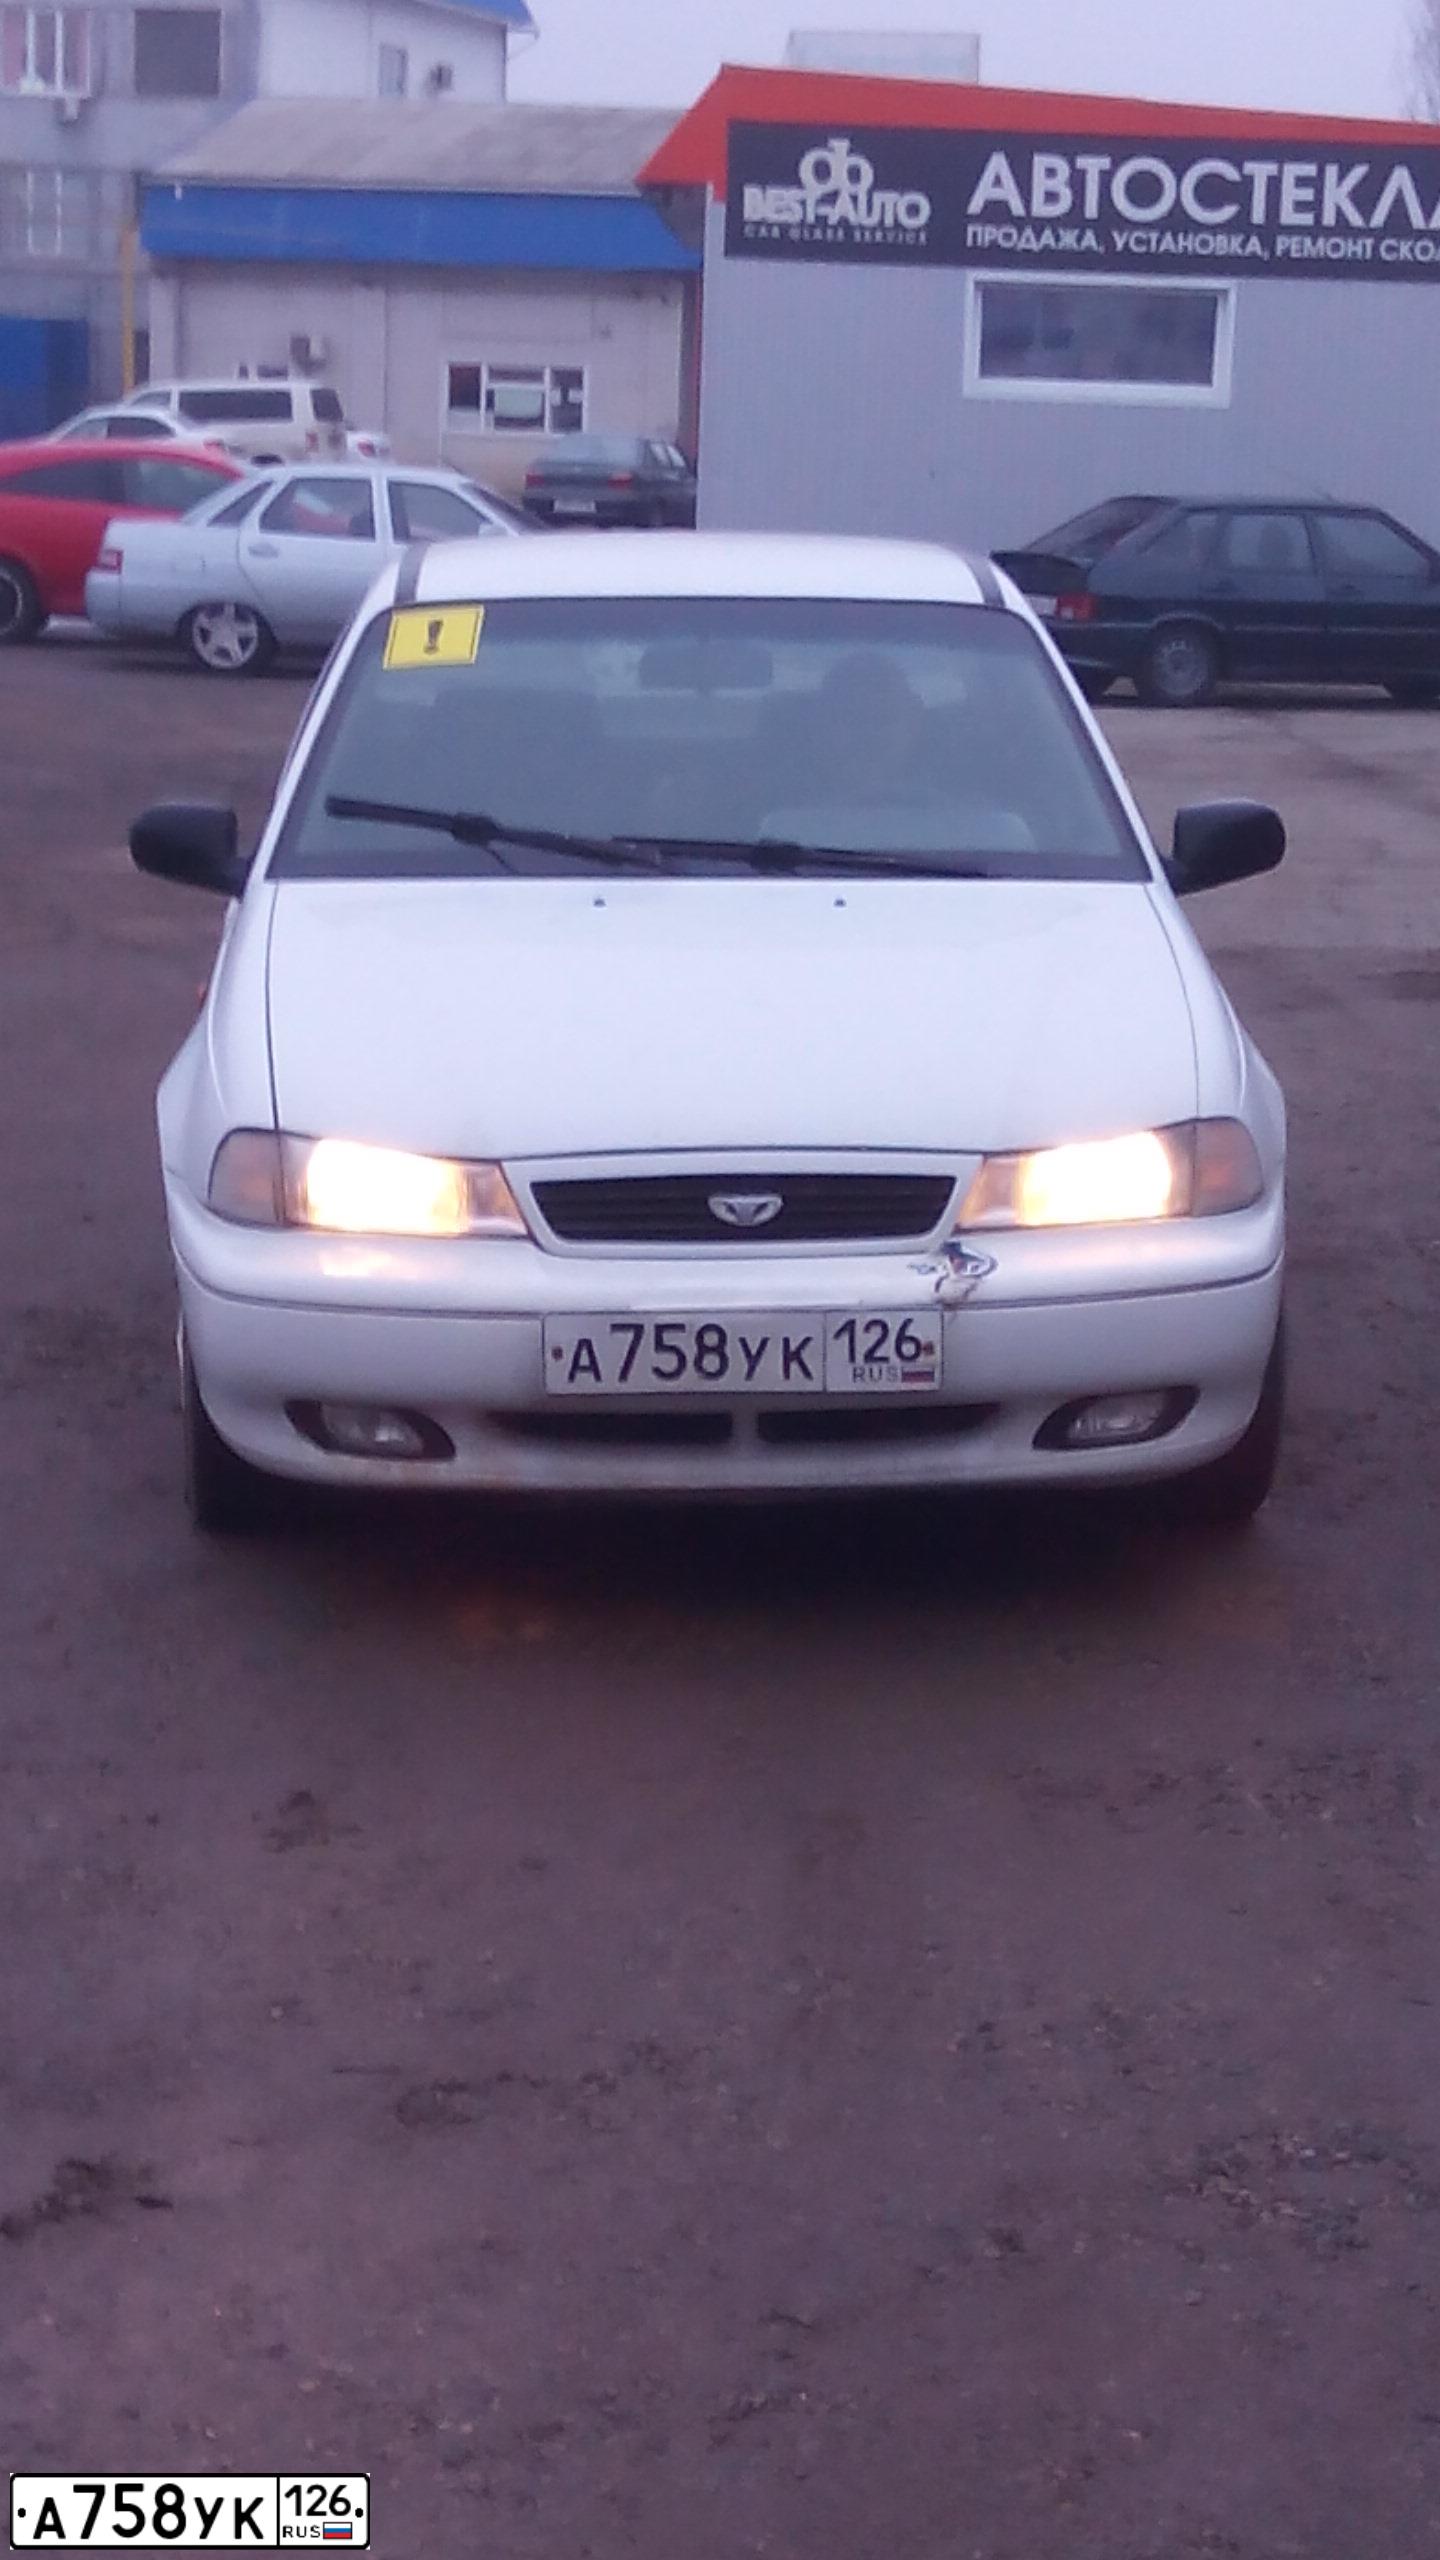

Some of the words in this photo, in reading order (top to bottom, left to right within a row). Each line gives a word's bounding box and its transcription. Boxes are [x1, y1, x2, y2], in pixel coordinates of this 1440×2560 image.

[966, 151, 1440, 230] АВТОСТЕКЛ
[966, 224, 1105, 253] ПРОДАЖА,
[1112, 231, 1270, 261] УСТАНОВКА,
[1275, 235, 1375, 260] РЕМОНТ
[567, 1322, 814, 1383] А758УК
[832, 1317, 922, 1364] 126
[852, 1368, 900, 1384] RUS
